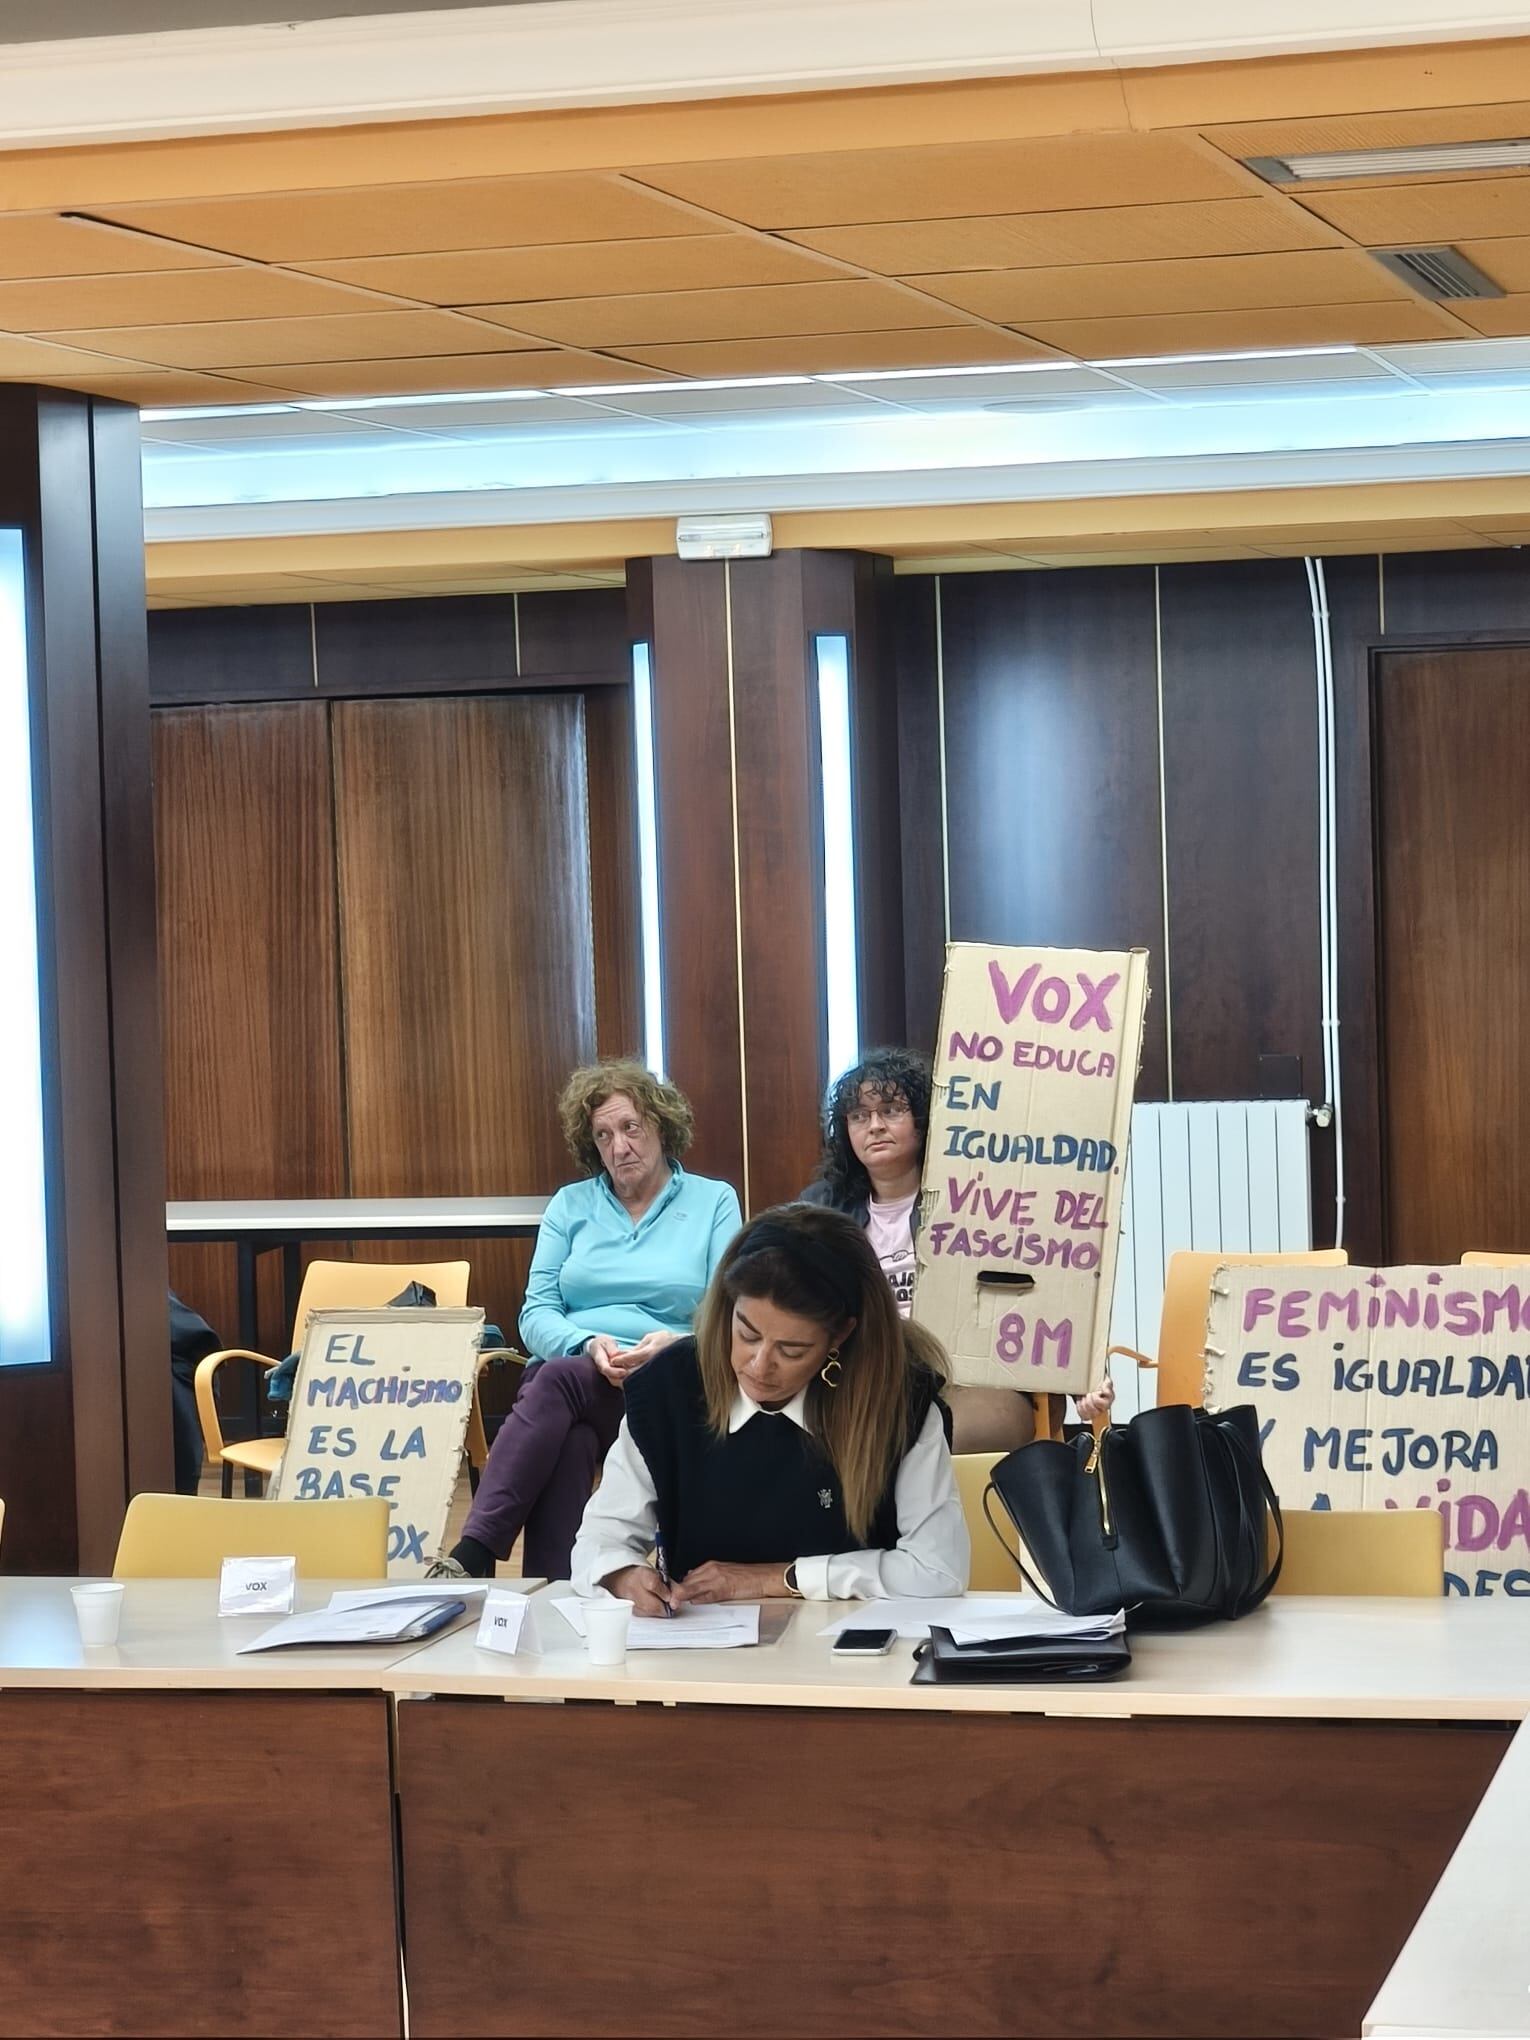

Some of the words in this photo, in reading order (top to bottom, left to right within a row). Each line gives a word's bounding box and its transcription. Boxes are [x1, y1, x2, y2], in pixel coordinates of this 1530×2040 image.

[987, 959, 1121, 1032] VOX
[949, 1031, 1003, 1062] NO
[1013, 1041, 1116, 1078] EDUCA
[946, 1076, 1002, 1111] EN
[1055, 1190, 1109, 1230] DEL
[325, 1334, 376, 1366] EL
[996, 1313, 1073, 1369] 8M
[1237, 1351, 1301, 1392] ES
[307, 1425, 357, 1458] ES
[380, 1426, 427, 1460] LA
[1303, 1427, 1499, 1476] MEJORA
[245, 1581, 268, 1591] VOX
